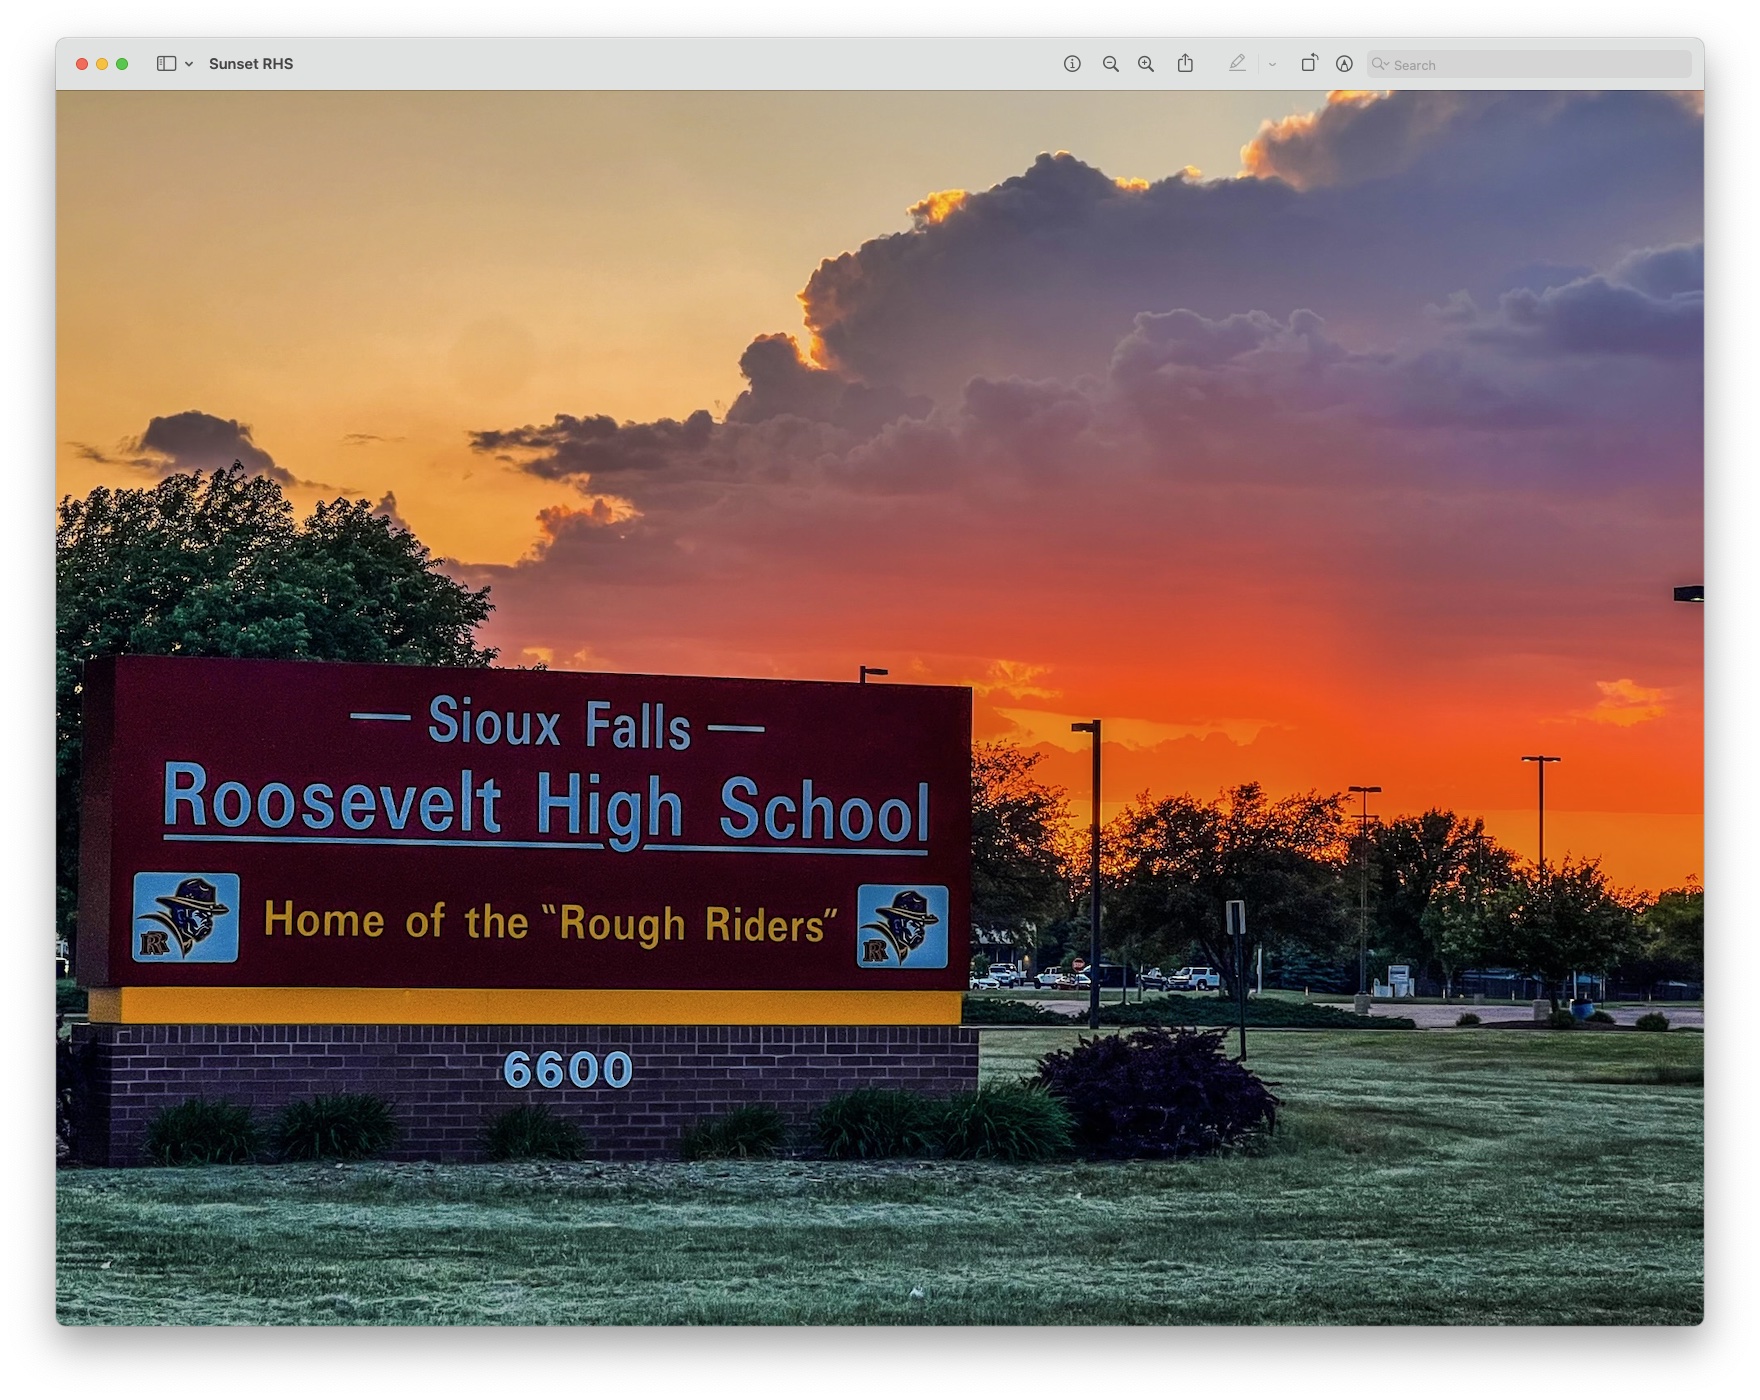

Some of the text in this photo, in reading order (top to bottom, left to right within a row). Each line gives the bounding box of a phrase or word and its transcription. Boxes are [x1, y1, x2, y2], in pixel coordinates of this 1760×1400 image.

[209, 57, 294, 70] Sunset RHS
[1394, 59, 1436, 71] Search
[428, 694, 691, 751] Sioux Falls
[164, 761, 929, 852] Roosevelt High School
[265, 900, 385, 938] Home
[406, 901, 446, 938] of
[464, 903, 529, 939] the
[503, 1051, 633, 1089] 6600
